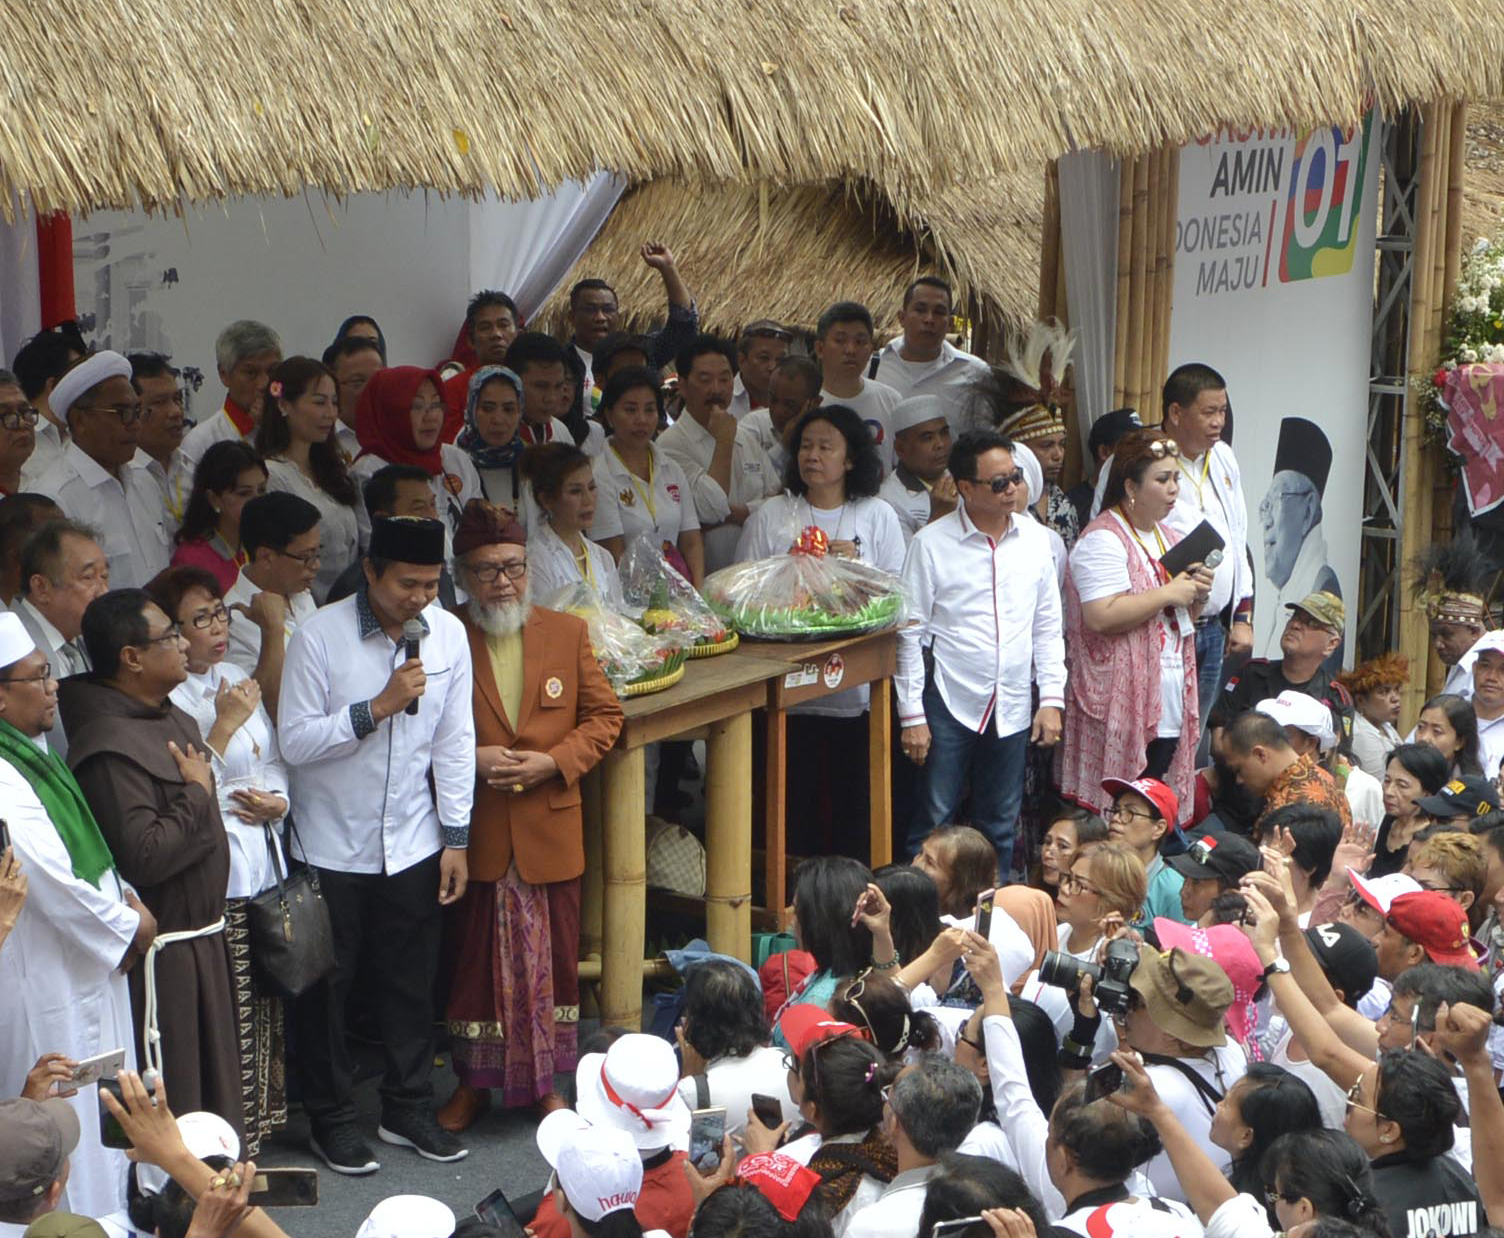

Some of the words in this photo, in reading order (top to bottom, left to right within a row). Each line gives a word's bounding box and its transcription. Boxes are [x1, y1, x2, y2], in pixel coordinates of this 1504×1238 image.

[1210, 147, 1284, 198] AMIN
[1294, 122, 1363, 248] 01
[1176, 211, 1262, 253] ONESIA
[1196, 255, 1259, 296] MAJU
